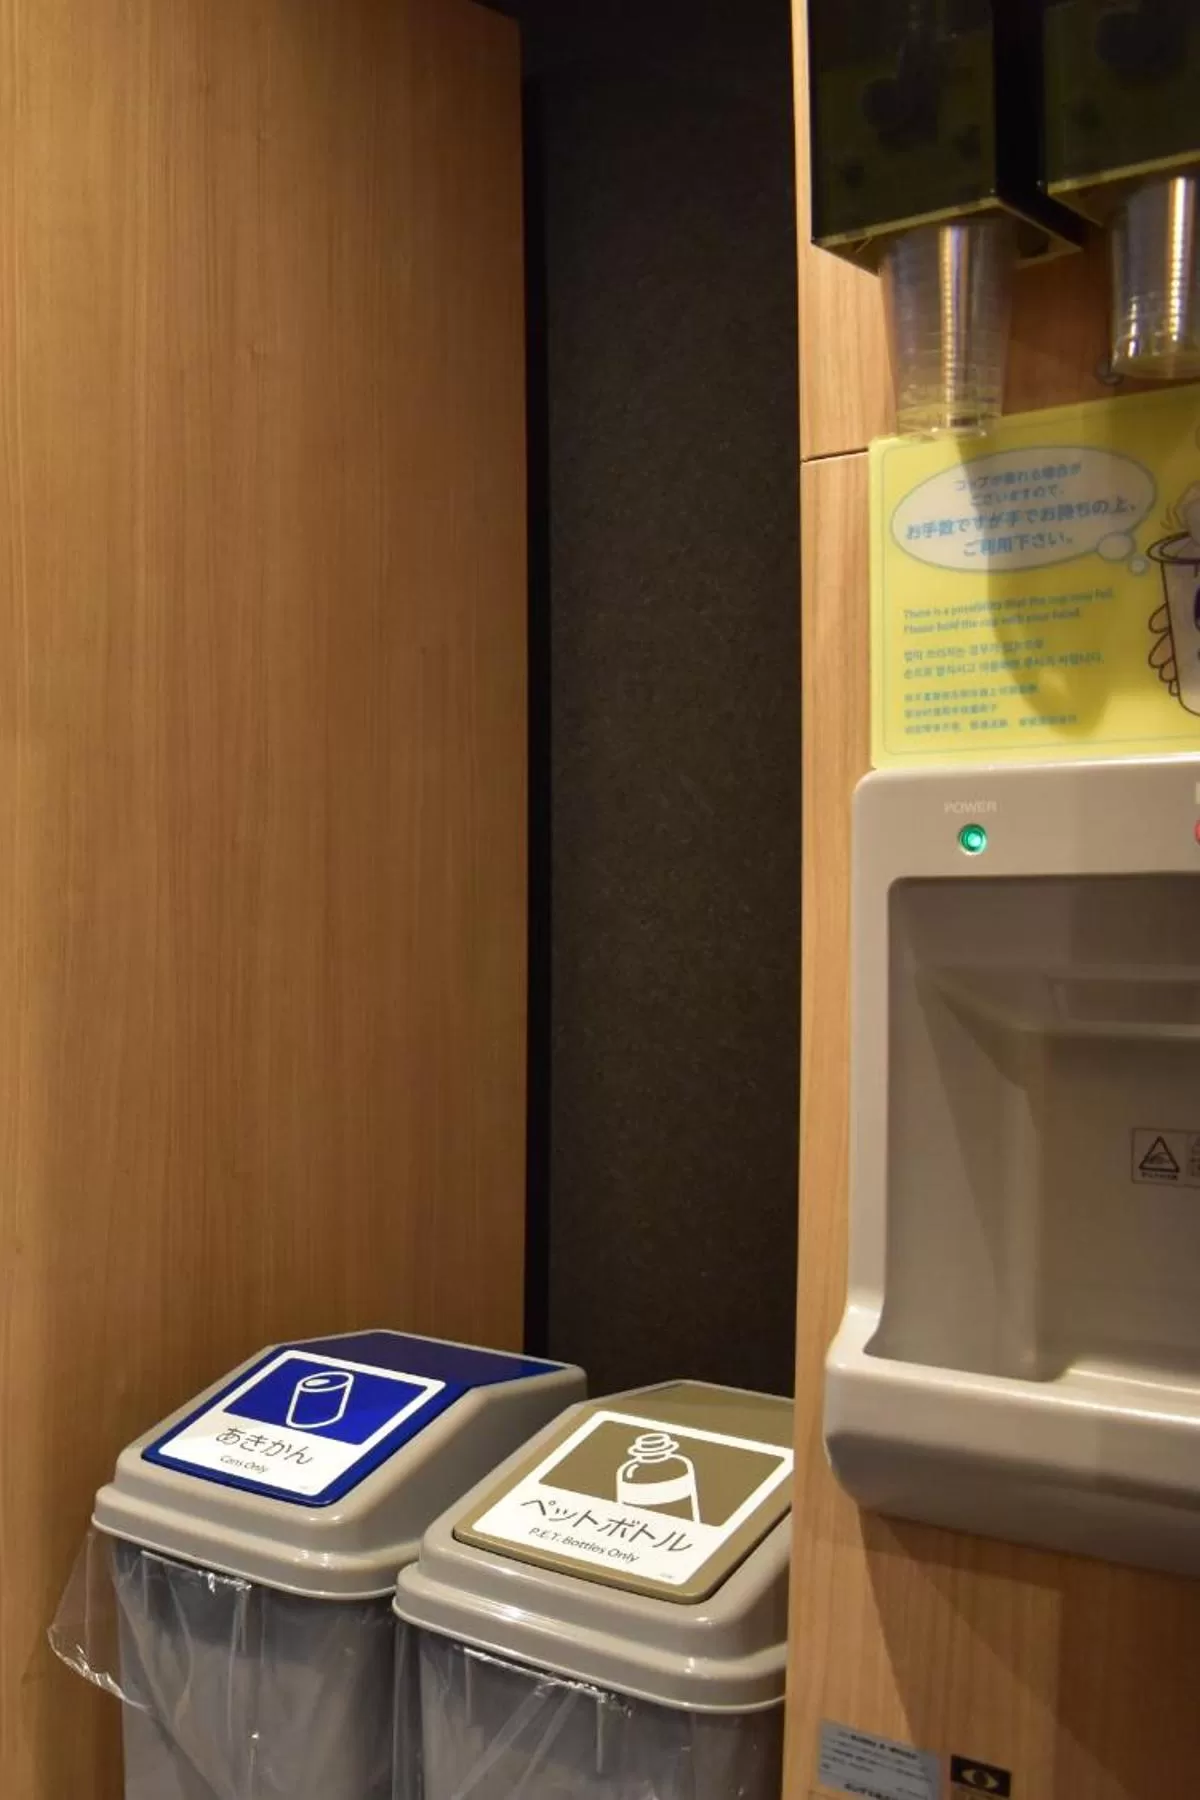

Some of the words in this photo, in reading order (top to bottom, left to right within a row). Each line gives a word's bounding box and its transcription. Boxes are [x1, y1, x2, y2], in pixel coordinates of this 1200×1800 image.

[944, 800, 997, 813] POWER
[215, 1426, 314, 1465] あきかん
[220, 1454, 243, 1470] Cans
[244, 1460, 268, 1474] Only
[521, 1499, 693, 1552] ペットボトル
[528, 1527, 561, 1546] P.E.T.
[562, 1535, 605, 1556] Bottles
[607, 1547, 640, 1564] Only
